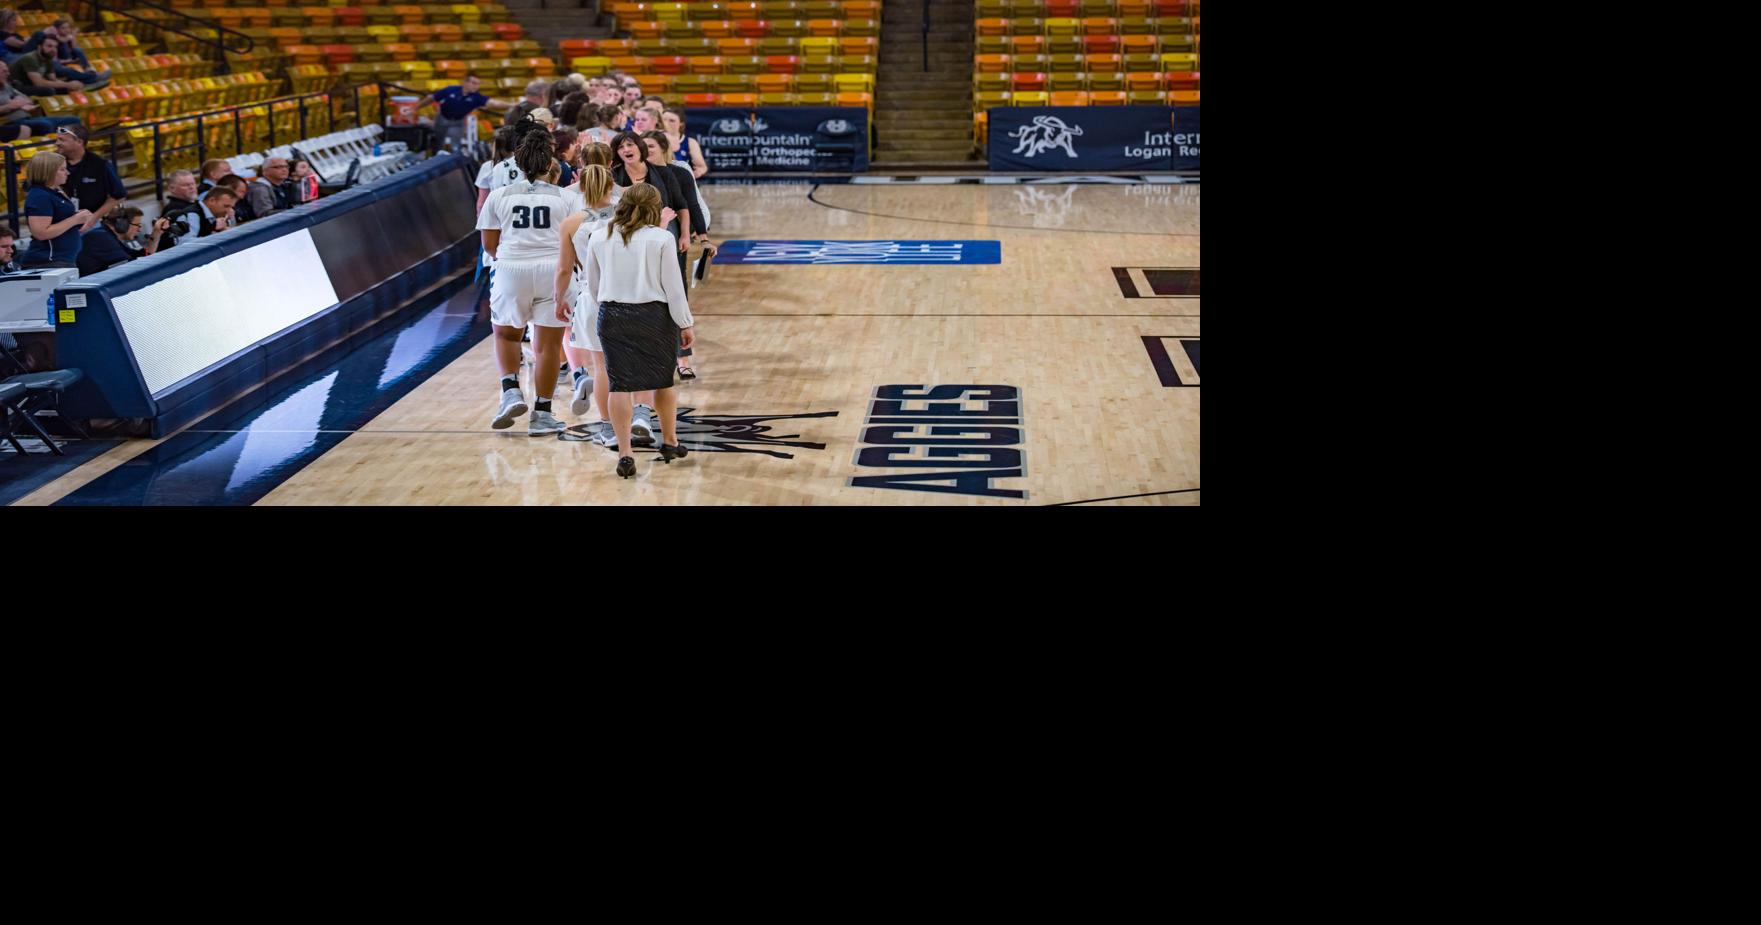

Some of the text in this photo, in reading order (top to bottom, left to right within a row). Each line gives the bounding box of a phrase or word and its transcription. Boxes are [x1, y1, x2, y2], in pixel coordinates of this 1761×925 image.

[697, 134, 810, 146] Intermountain
[1124, 146, 1200, 159] Logan Re
[756, 156, 810, 166] Medicine
[512, 205, 551, 229] 30
[846, 384, 1030, 499] AGGIES
